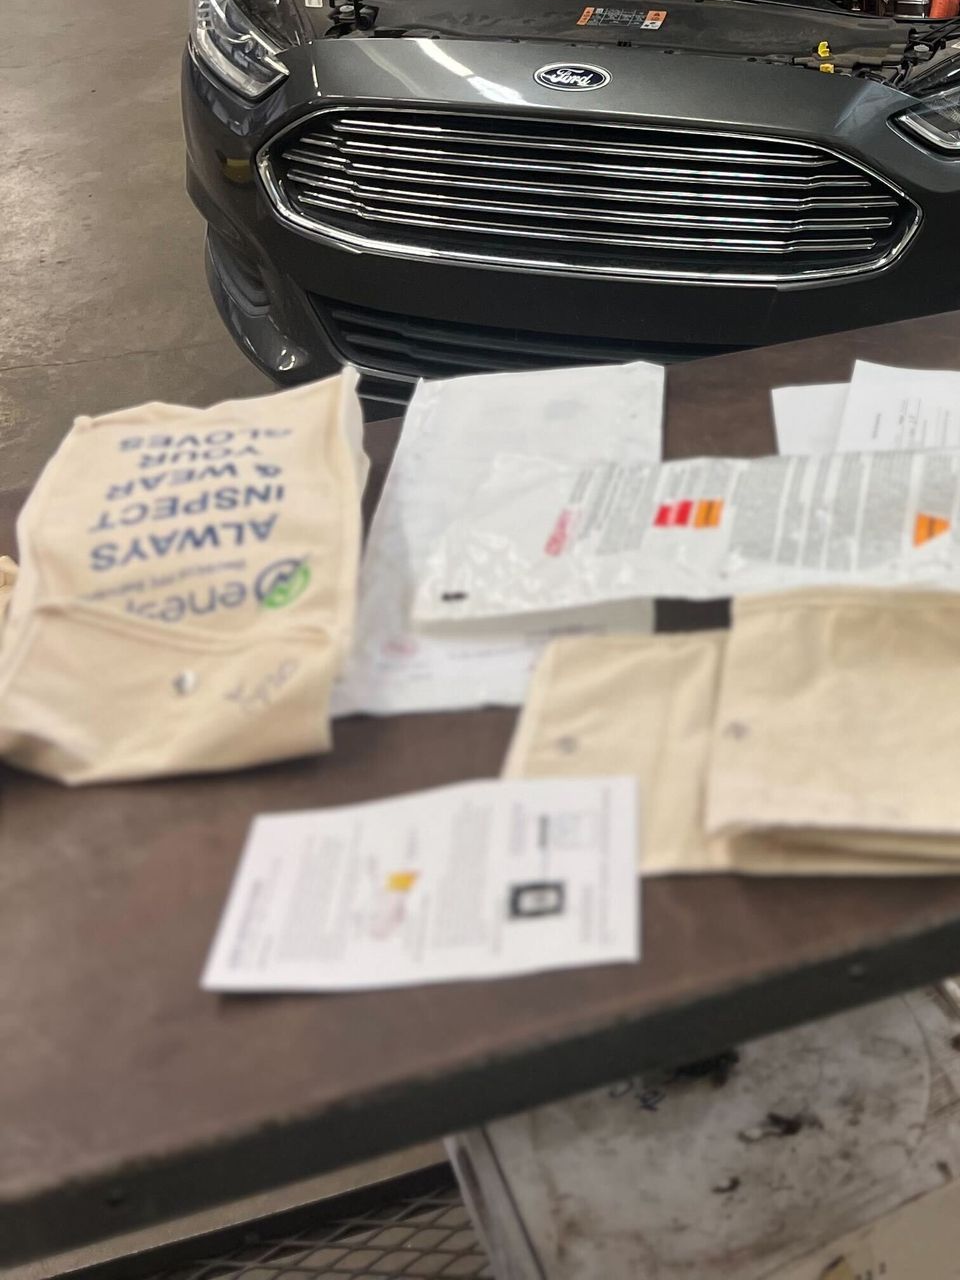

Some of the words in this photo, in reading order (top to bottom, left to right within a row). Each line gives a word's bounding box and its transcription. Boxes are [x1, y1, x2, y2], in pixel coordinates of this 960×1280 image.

[546, 67, 595, 87] Ford
[139, 444, 262, 470] YOUR
[106, 462, 239, 501] WEAR
[88, 484, 285, 534] INSPECT
[90, 513, 279, 572] ALWAYS
